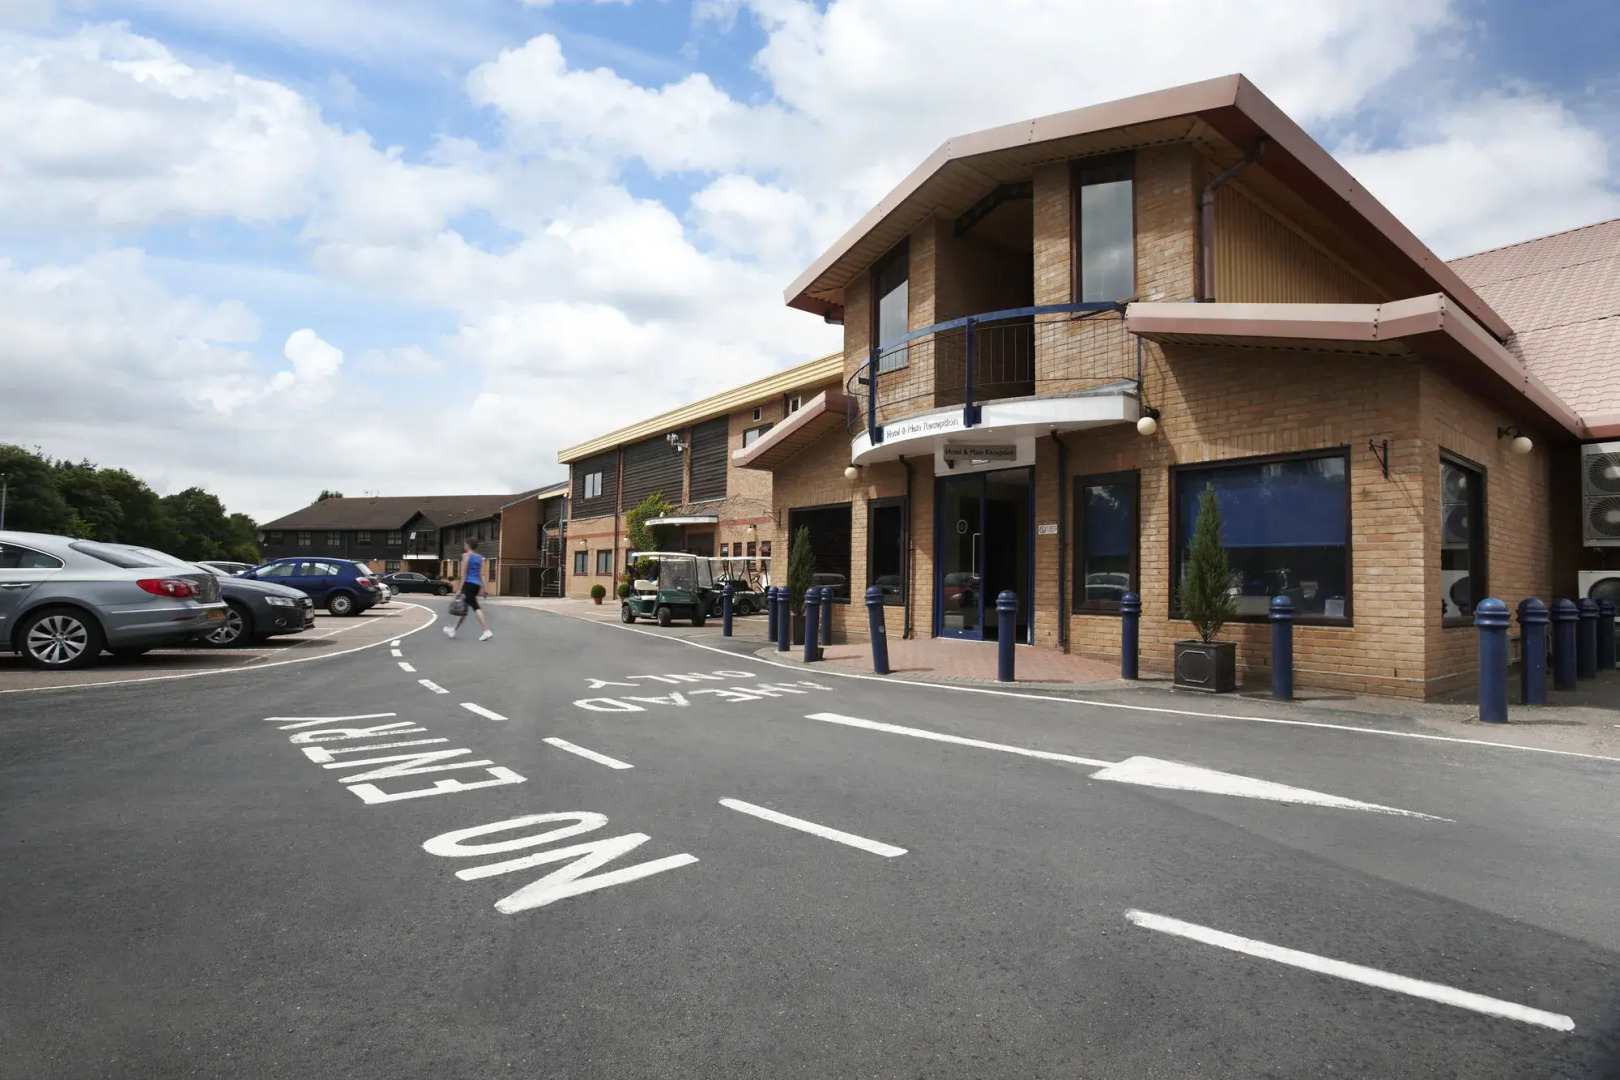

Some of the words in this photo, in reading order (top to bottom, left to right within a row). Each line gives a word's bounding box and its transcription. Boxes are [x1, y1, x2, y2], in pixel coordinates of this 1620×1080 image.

[886, 428, 900, 439] Hotel
[901, 426, 907, 435] &
[907, 423, 921, 434] Main
[923, 418, 959, 430] Reception
[945, 448, 962, 456] Hotel
[963, 448, 968, 456] &
[969, 448, 984, 456] Main
[985, 448, 1015, 457] Reception
[583, 670, 756, 689] ONLY
[572, 680, 834, 712] AHEAD
[263, 713, 528, 805] ENTRY
[422, 811, 700, 914] NO
